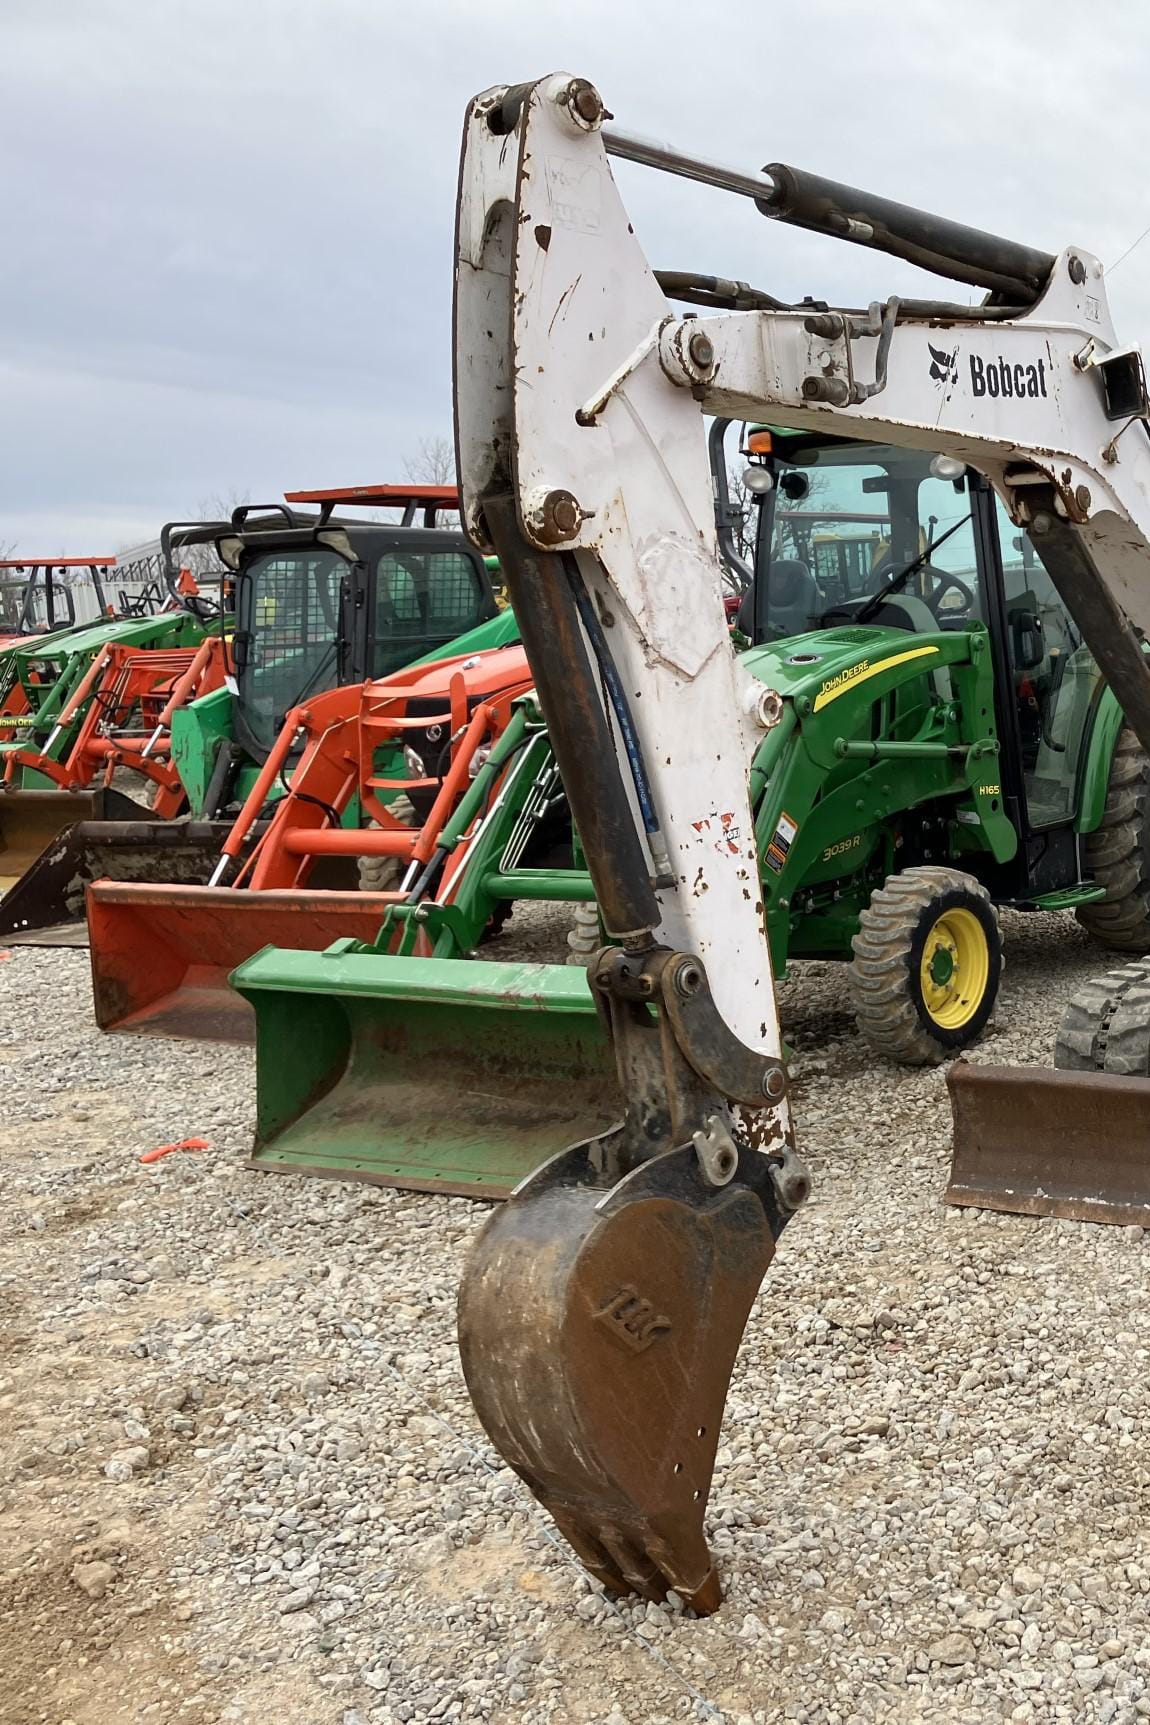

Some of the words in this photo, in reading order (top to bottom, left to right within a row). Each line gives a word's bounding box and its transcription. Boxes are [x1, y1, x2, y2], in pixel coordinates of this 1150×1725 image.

[969, 354, 1048, 398] Bobcat
[820, 675, 843, 695] JOHN
[842, 659, 870, 682] DEERE
[979, 785, 1000, 796] H165
